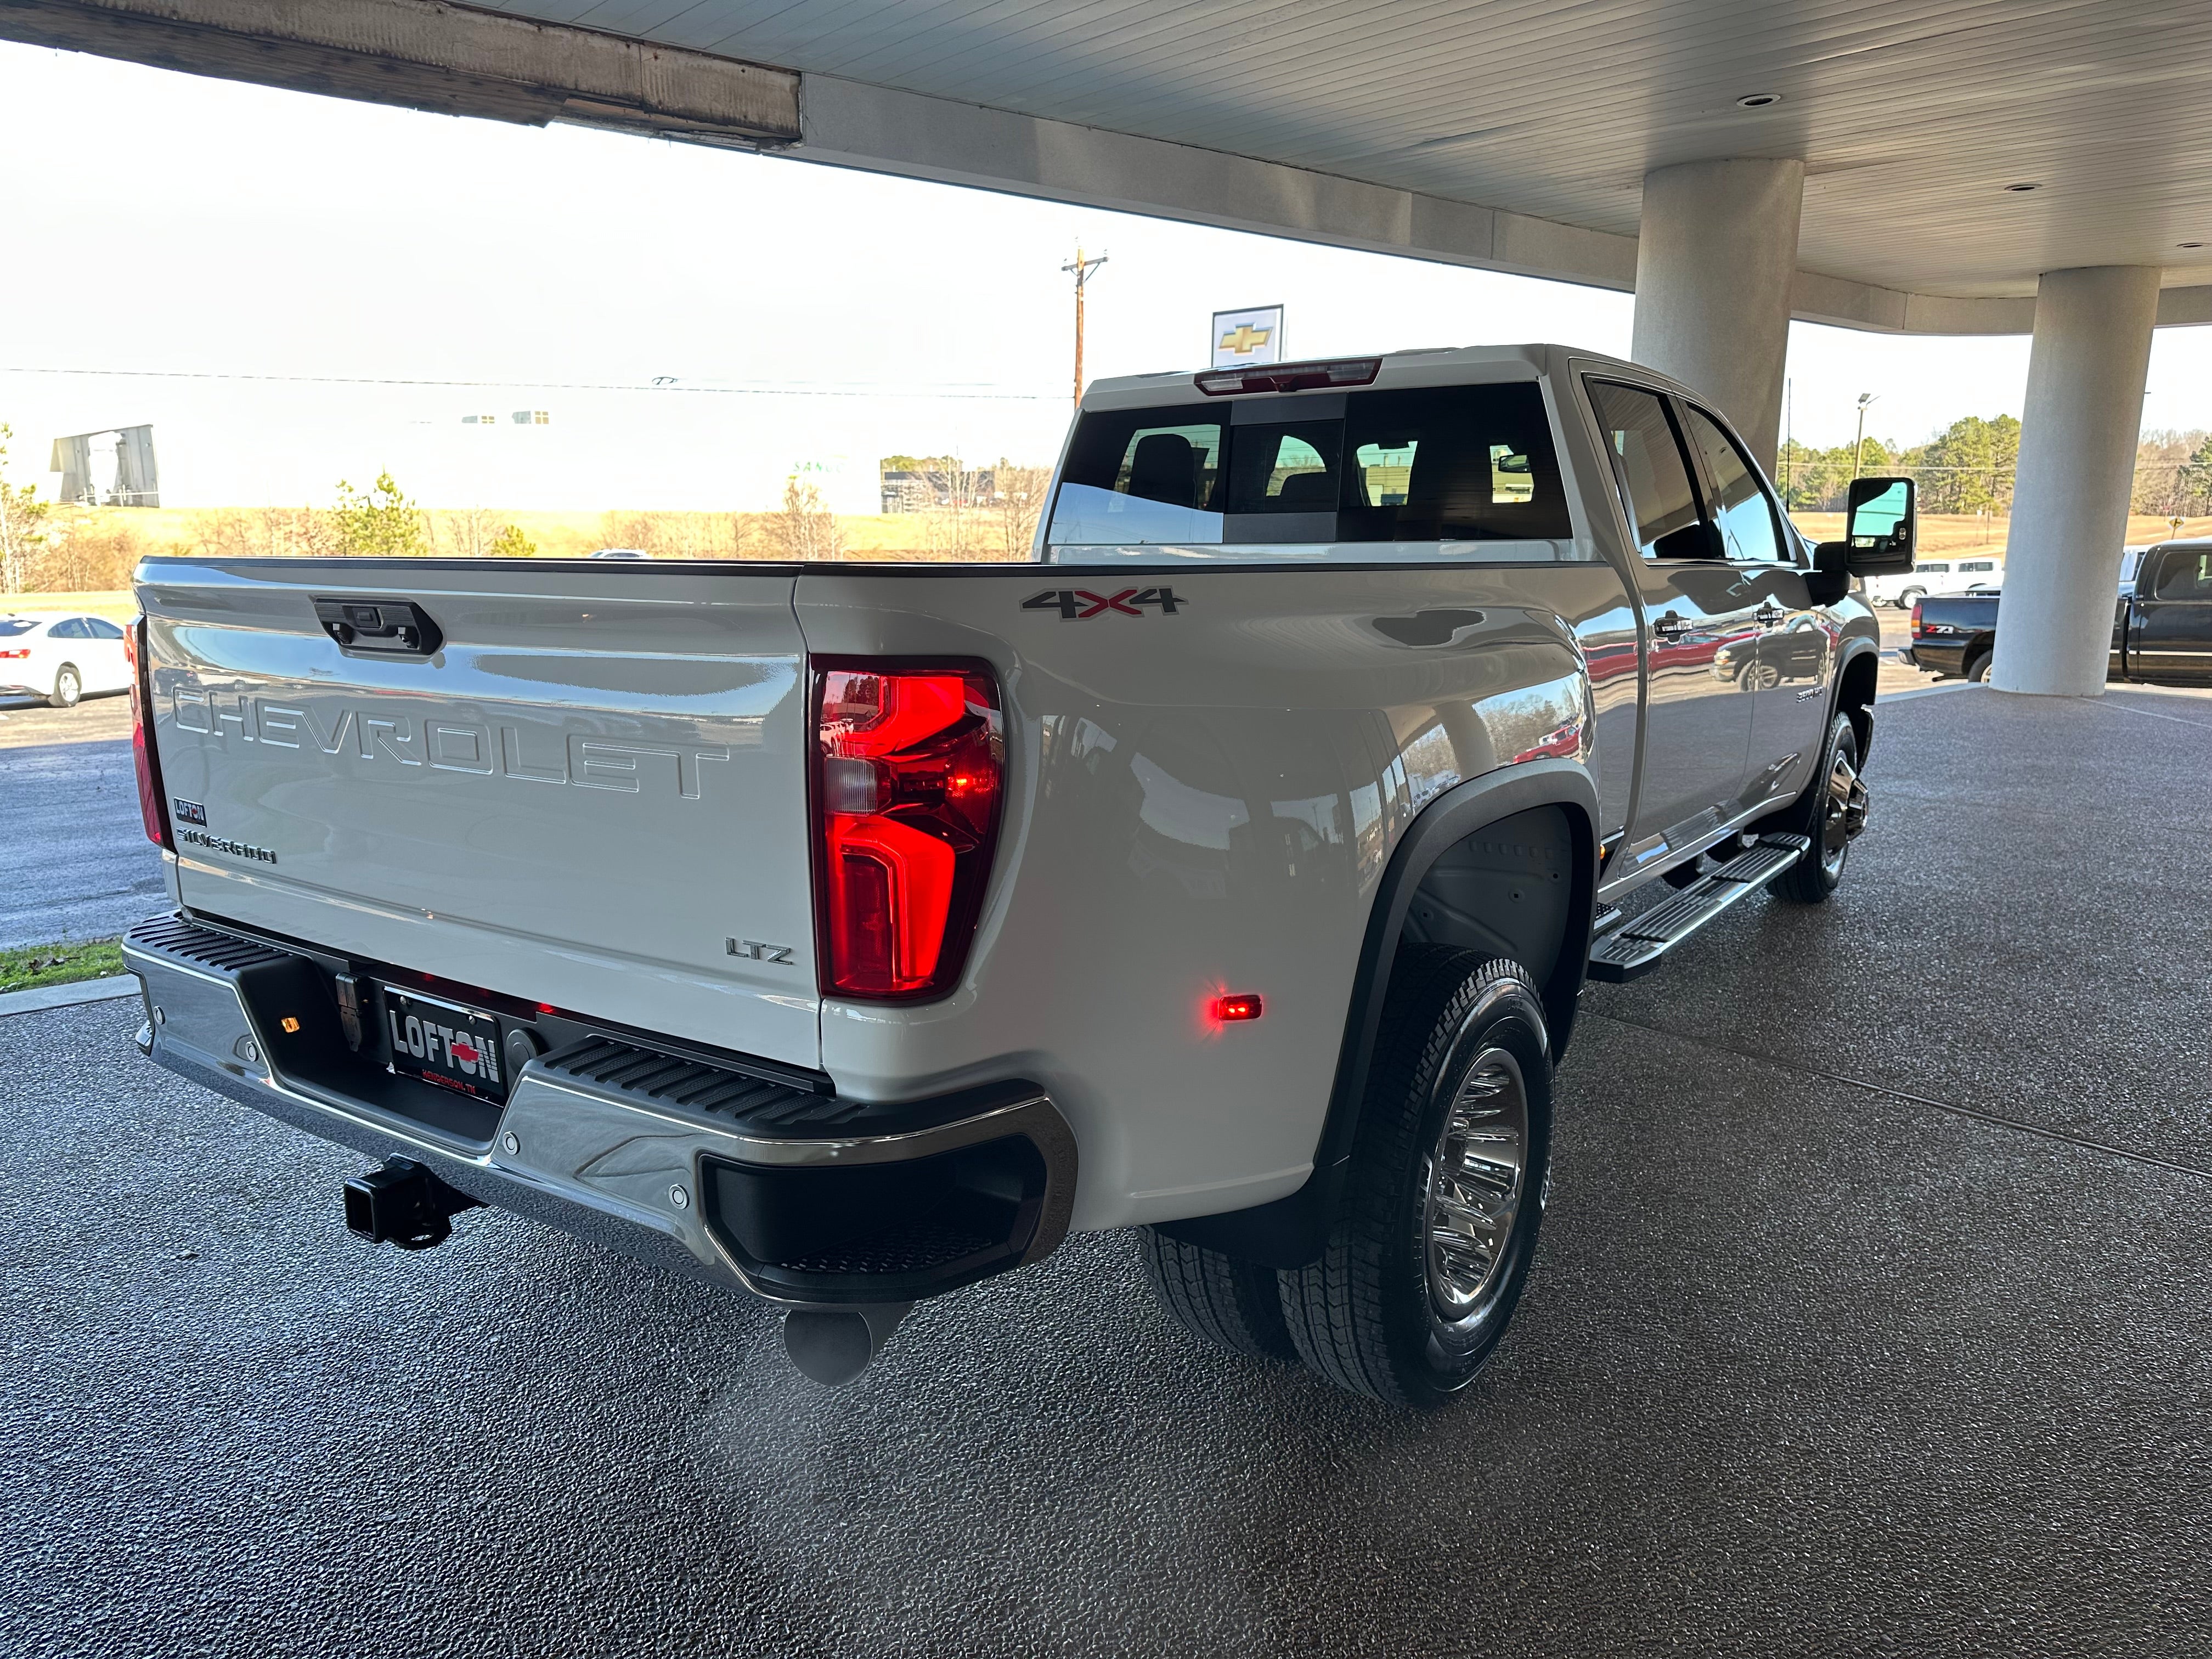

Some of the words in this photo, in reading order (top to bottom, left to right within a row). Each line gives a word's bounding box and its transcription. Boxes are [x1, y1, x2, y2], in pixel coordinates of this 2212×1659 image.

[1022, 588, 1187, 619] 4X4
[1926, 625, 1954, 634] Z71
[174, 686, 730, 799] CHEVROLET
[174, 800, 205, 821] LOFTON
[176, 826, 276, 864] SILVERADO
[725, 936, 793, 965] LTZ
[389, 1009, 500, 1084] LOFTON
[465, 1083, 476, 1094] TN
